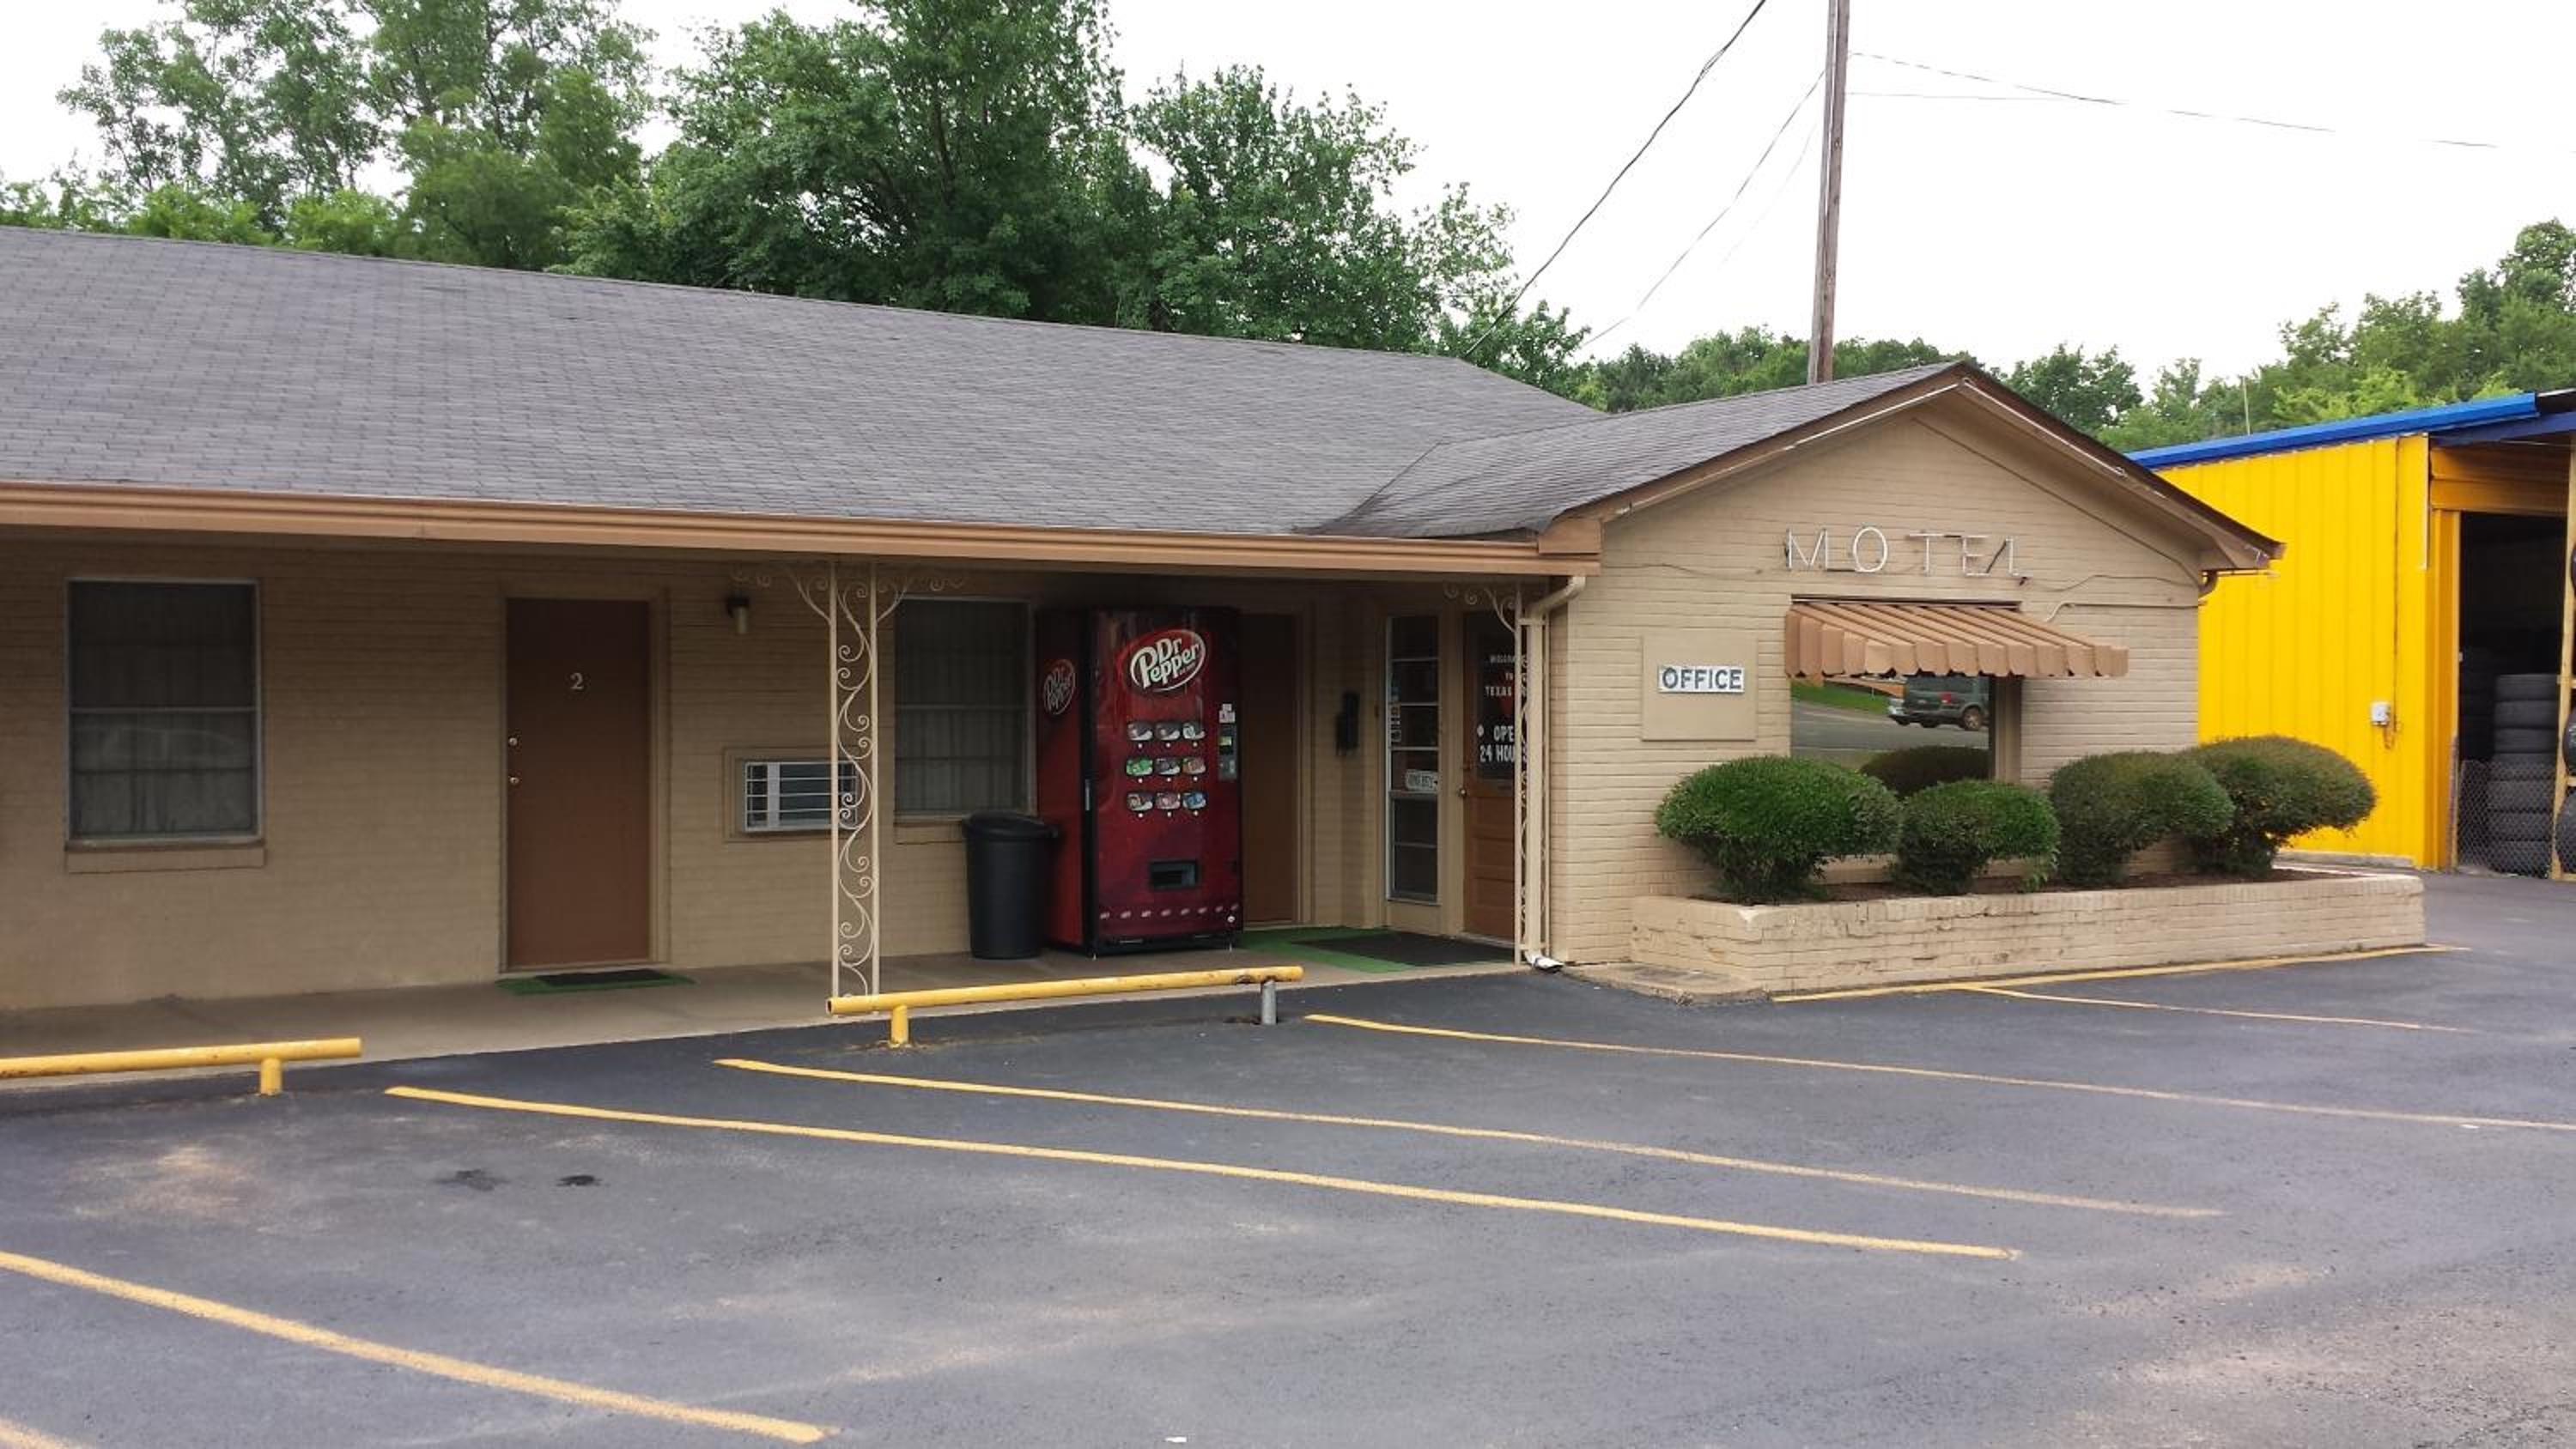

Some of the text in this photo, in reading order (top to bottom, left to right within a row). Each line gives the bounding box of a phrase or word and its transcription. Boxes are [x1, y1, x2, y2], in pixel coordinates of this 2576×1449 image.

[1786, 526, 2032, 577] MOTEL
[1155, 638, 1182, 664] Dr
[1135, 643, 1200, 689] Pepper
[569, 672, 585, 690] 2
[1662, 668, 1742, 689] OFFICE
[1485, 686, 1512, 697] TEXAS
[1493, 724, 1515, 742] OPE
[1479, 744, 1493, 762] 24
